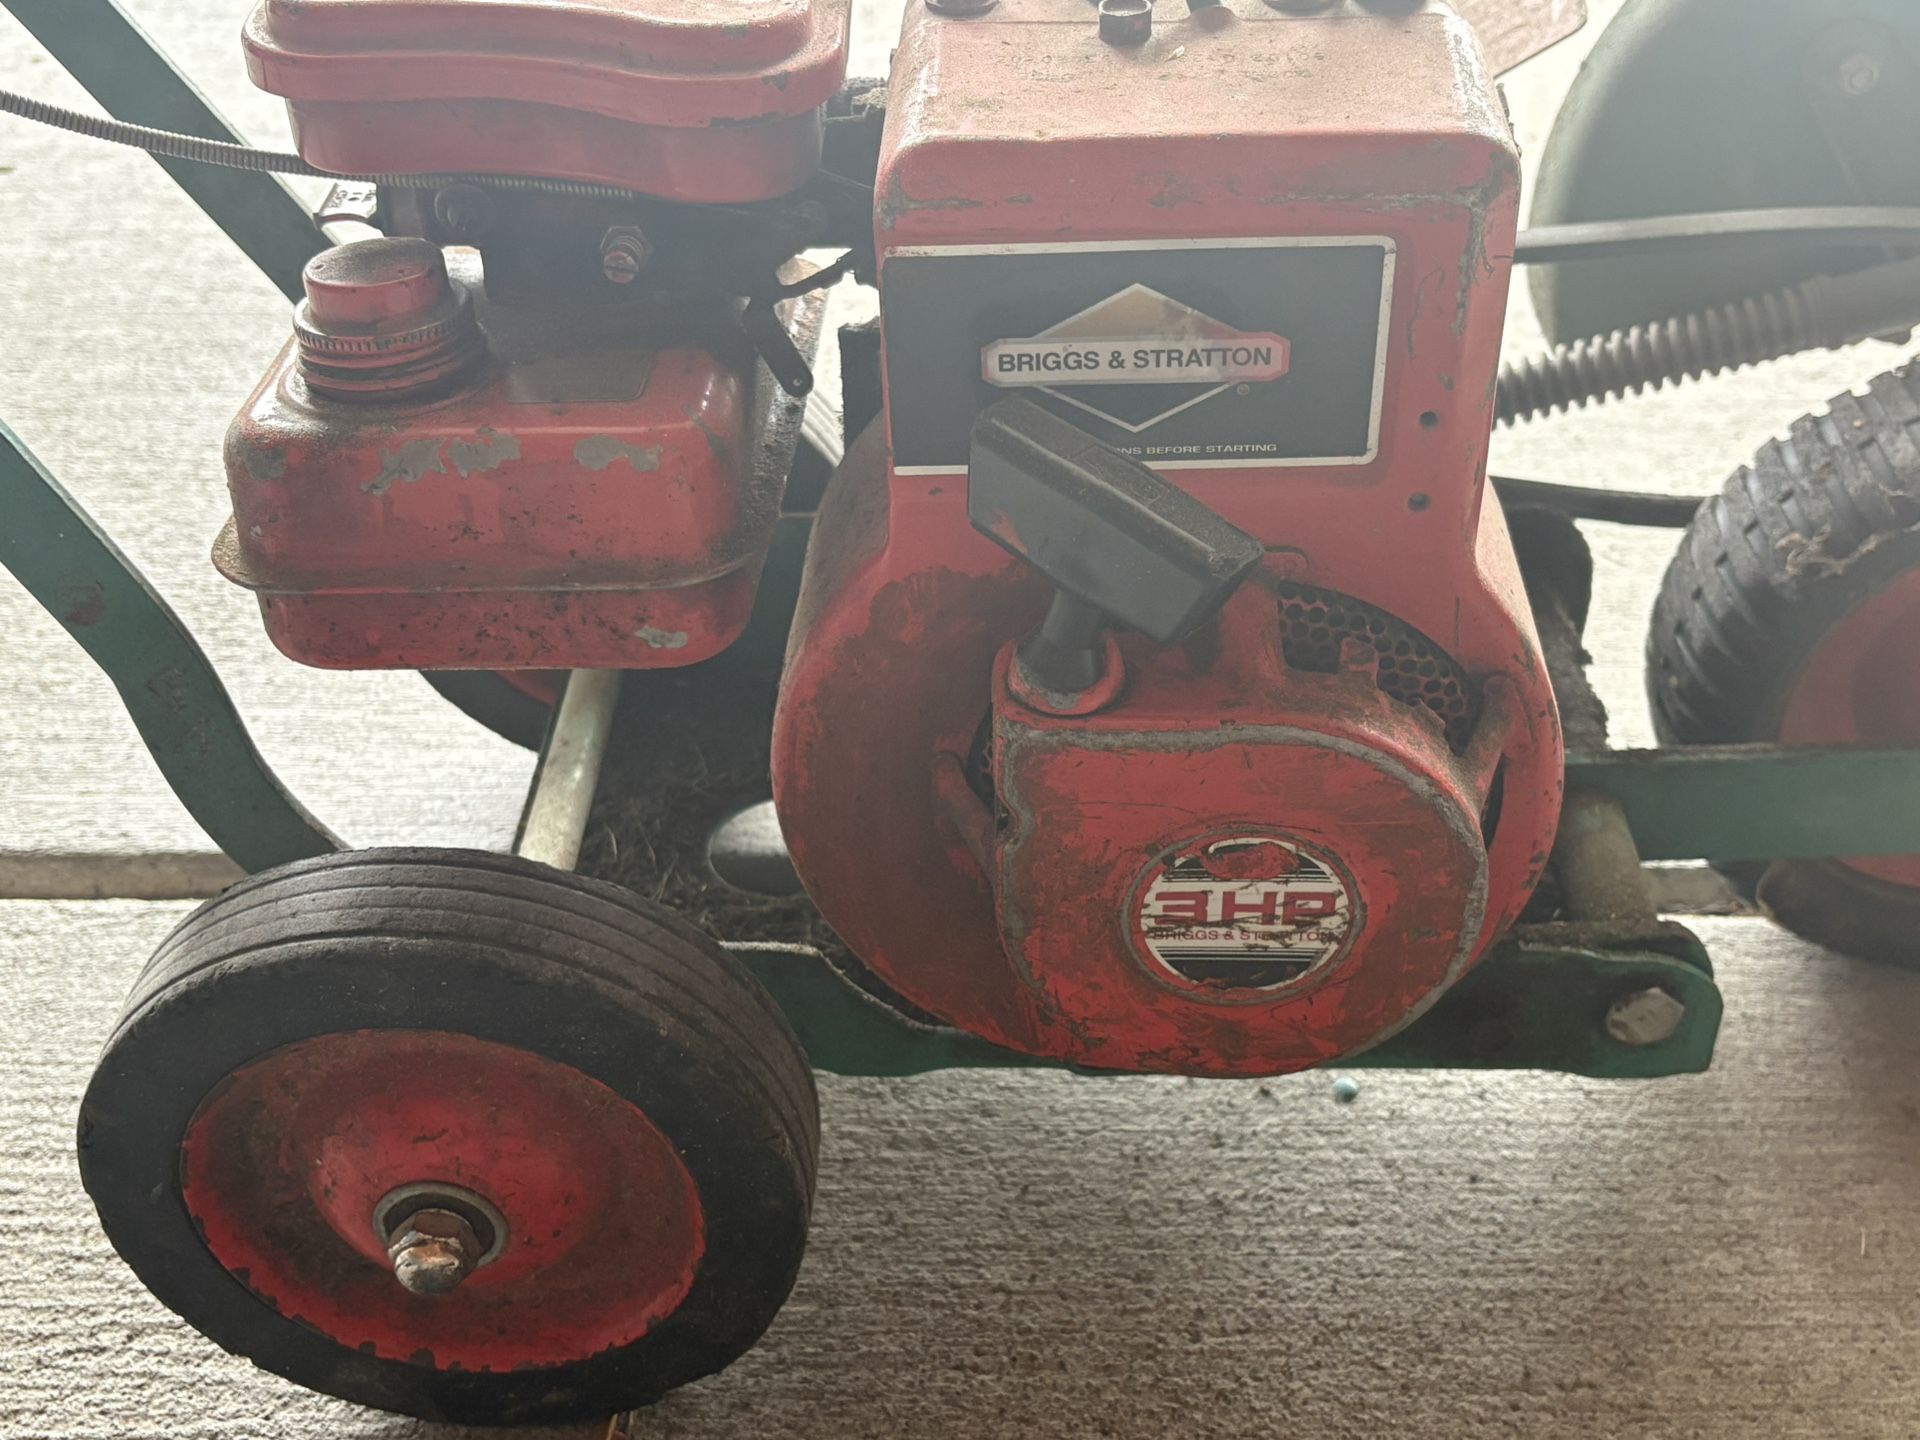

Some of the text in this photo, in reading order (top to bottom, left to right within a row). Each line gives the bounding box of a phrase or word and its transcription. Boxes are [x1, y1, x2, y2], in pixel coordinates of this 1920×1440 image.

[998, 347, 1272, 372] BRIGGS & STRATTON
[1146, 445, 1201, 455] BEFORE
[1205, 443, 1278, 453] STARTING
[1223, 930, 1235, 941] &
[1240, 929, 1335, 942] STTTO
